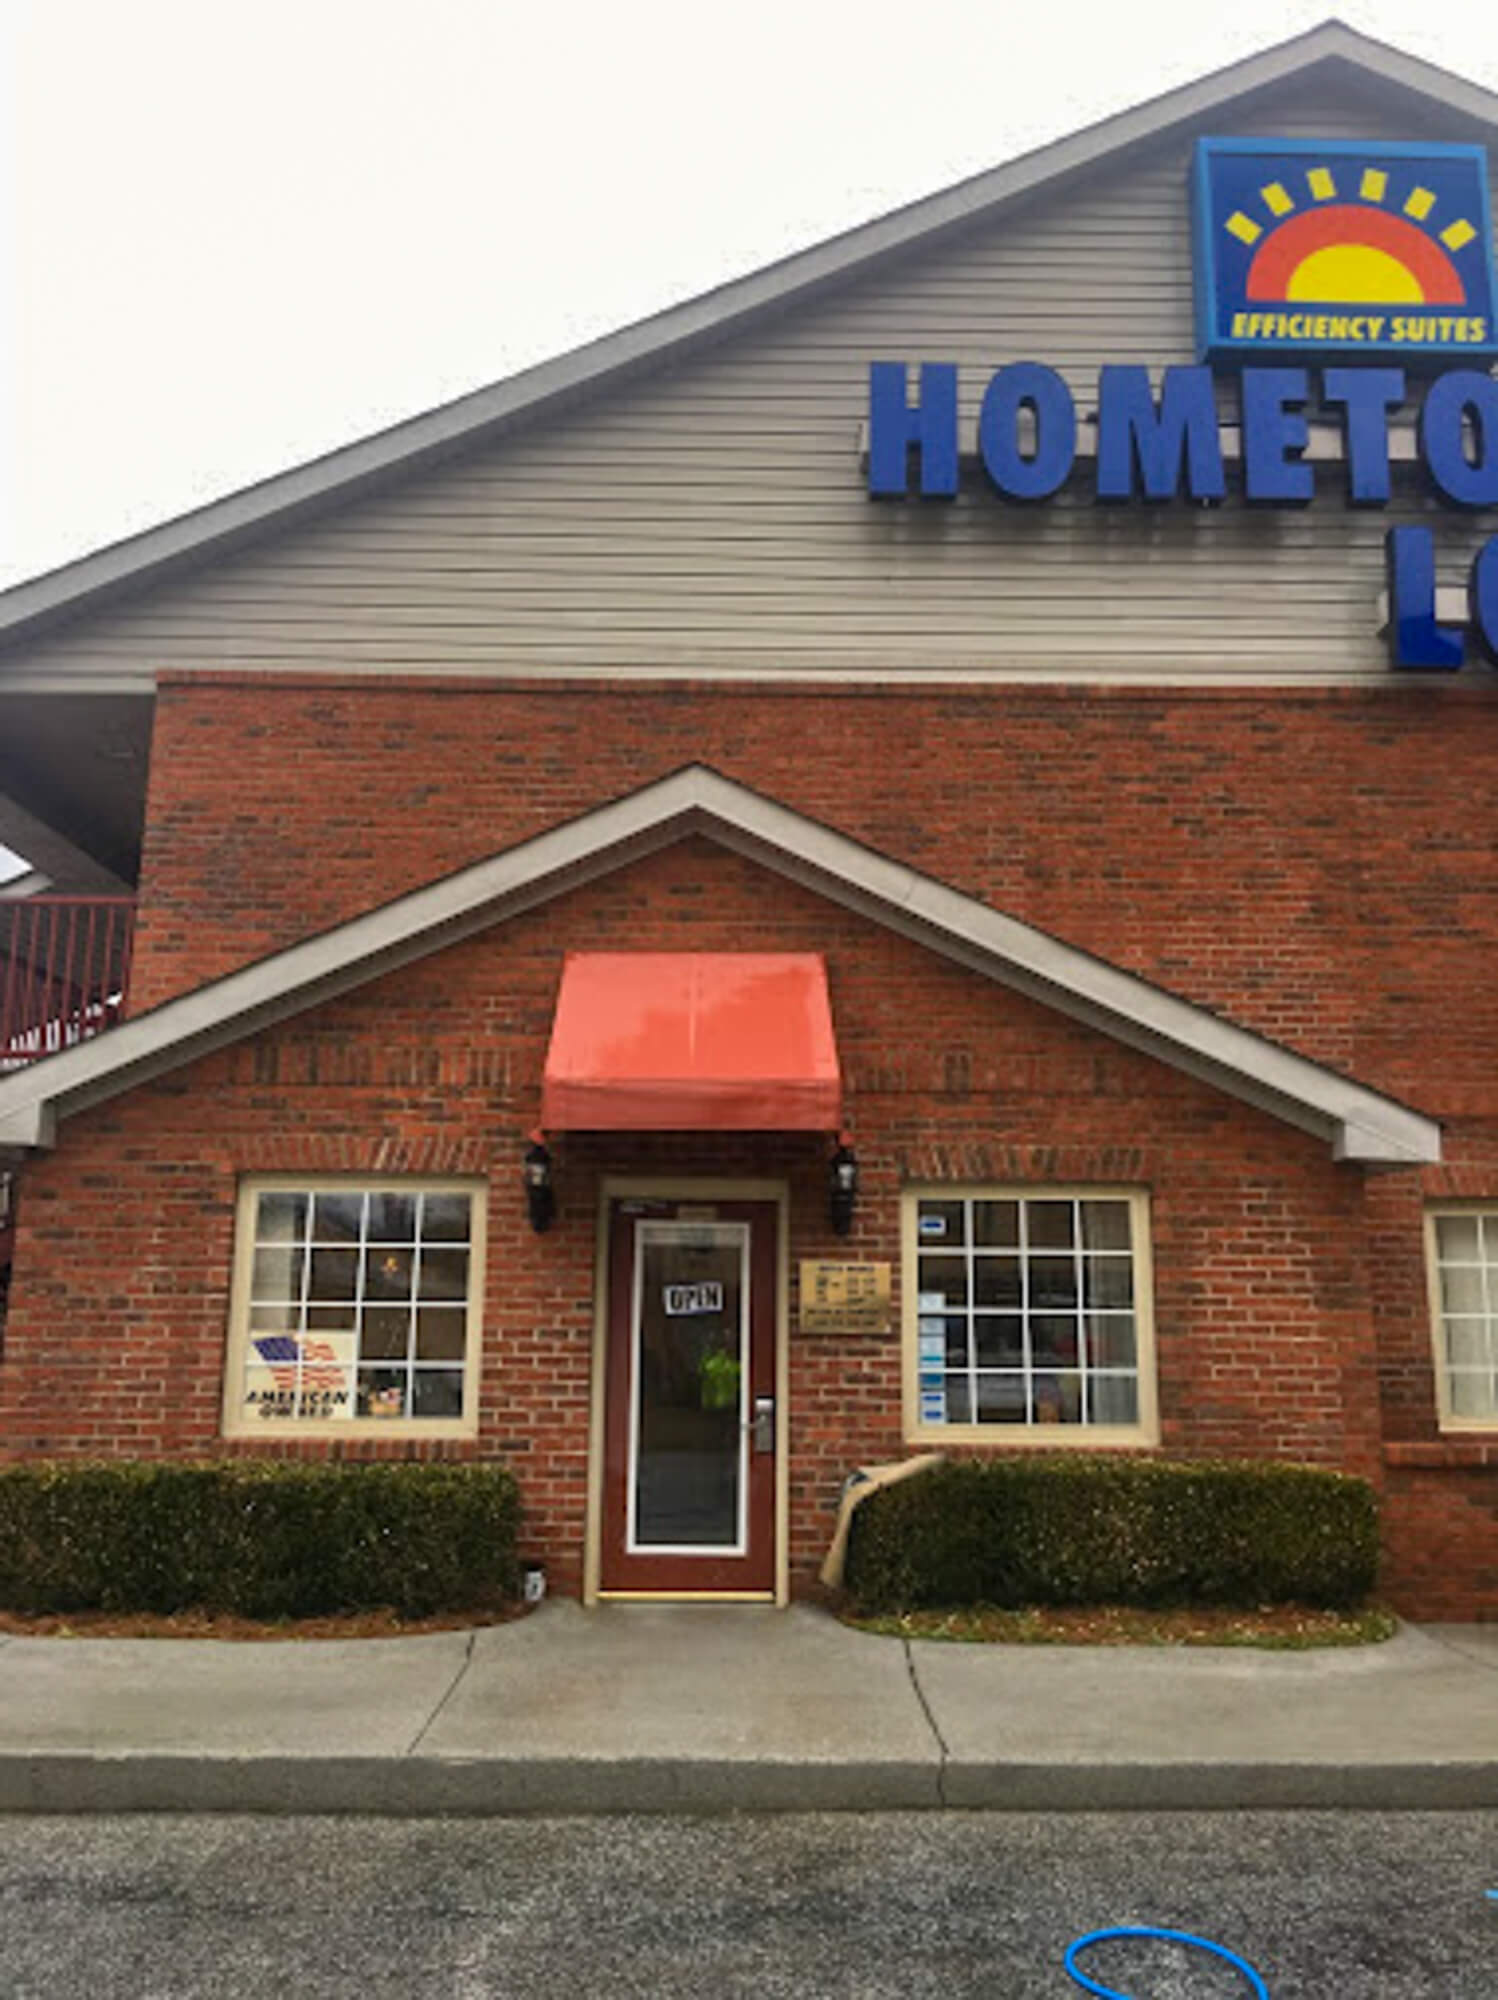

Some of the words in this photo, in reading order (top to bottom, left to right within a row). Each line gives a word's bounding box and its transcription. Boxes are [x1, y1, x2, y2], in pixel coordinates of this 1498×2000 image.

[1231, 313, 1386, 341] EFFICIENCY
[1390, 317, 1486, 343] SUITES
[1393, 525, 1498, 667] L
[669, 1285, 719, 1311] OPEN
[245, 1390, 349, 1405] AMERICAN
